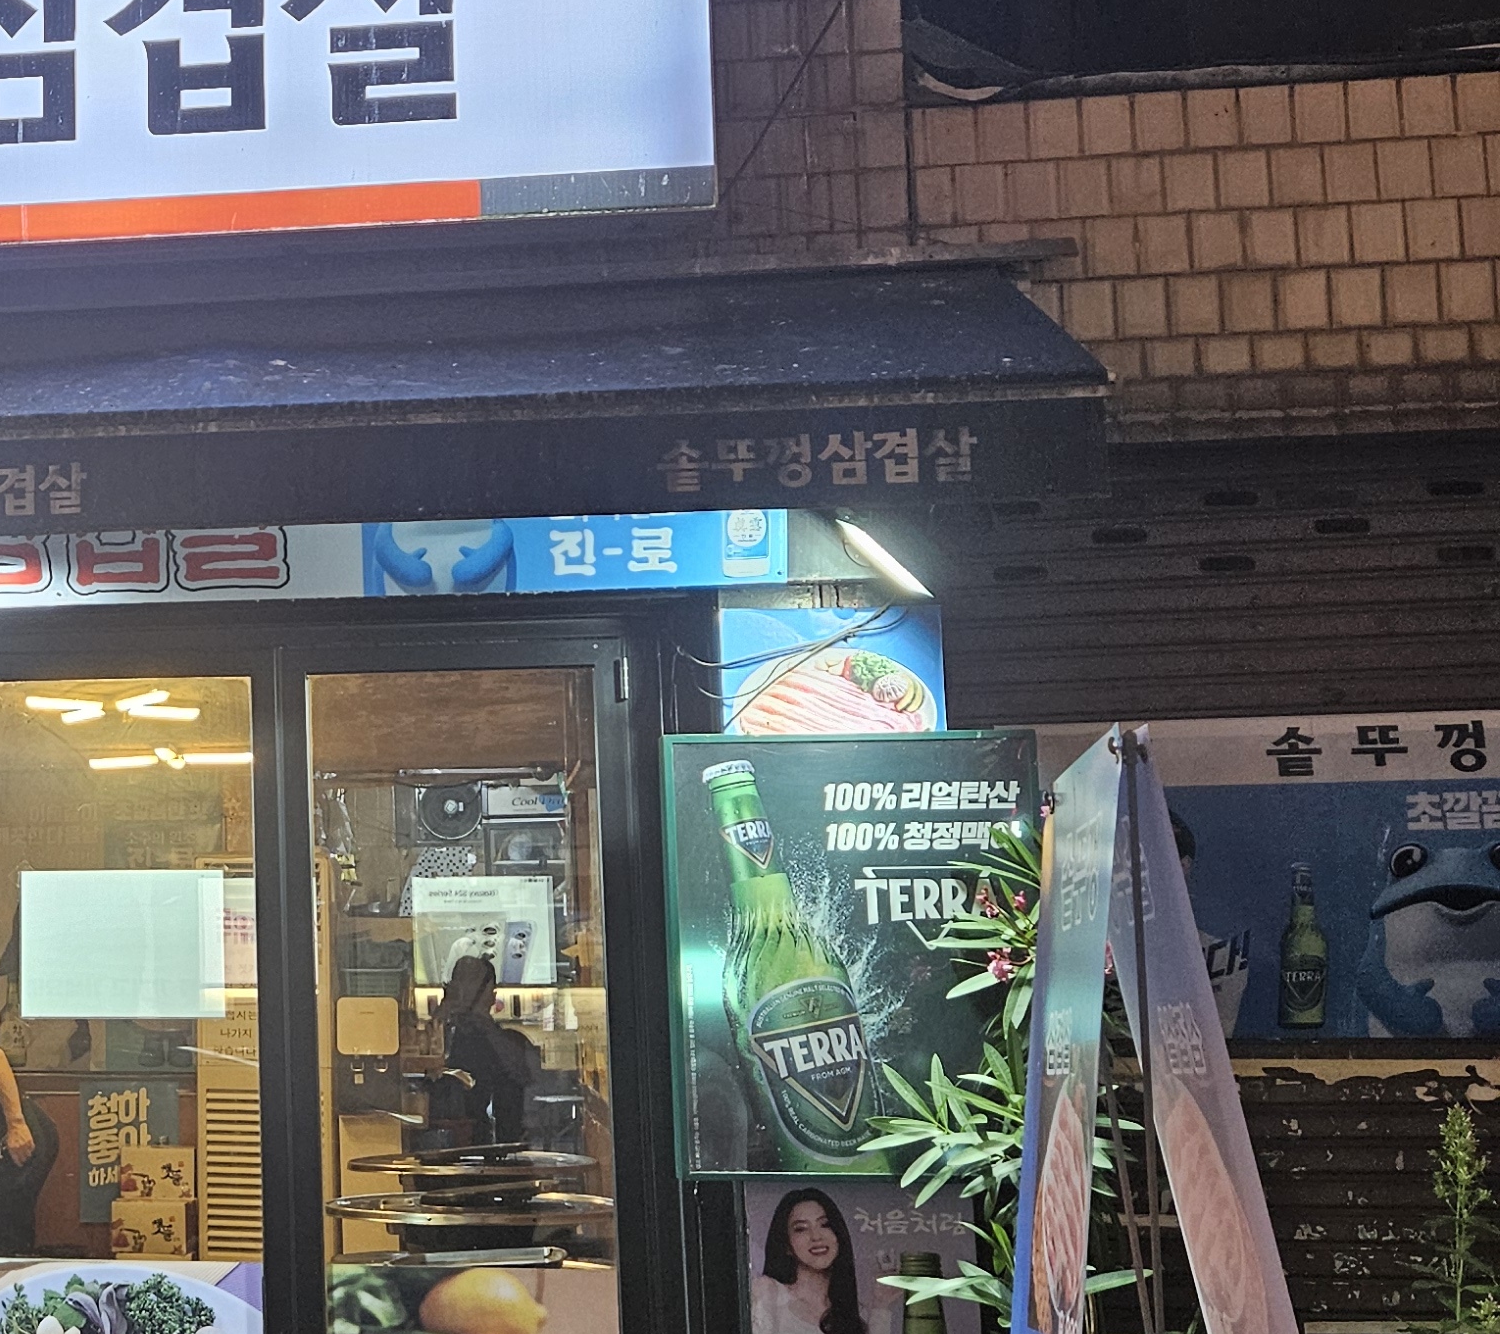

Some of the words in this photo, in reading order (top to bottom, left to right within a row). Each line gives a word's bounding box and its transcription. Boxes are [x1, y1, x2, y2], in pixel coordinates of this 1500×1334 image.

[656, 425, 978, 493] 솥뚜껑삼겹살
[1265, 719, 1488, 778] 솥뚜껑
[511, 796, 538, 807] Cool
[823, 781, 898, 812] 100%
[900, 780, 1021, 810] 리얼탄산
[825, 822, 900, 852] 100%
[854, 870, 998, 926] TERRA
[1284, 970, 1322, 983] TERRA
[219, 1028, 252, 1039] 나가지
[763, 1023, 868, 1080] TERRA
[811, 1070, 834, 1082] FROM
[87, 1087, 150, 1130] 청하
[854, 1207, 967, 1236] 처음처럼
